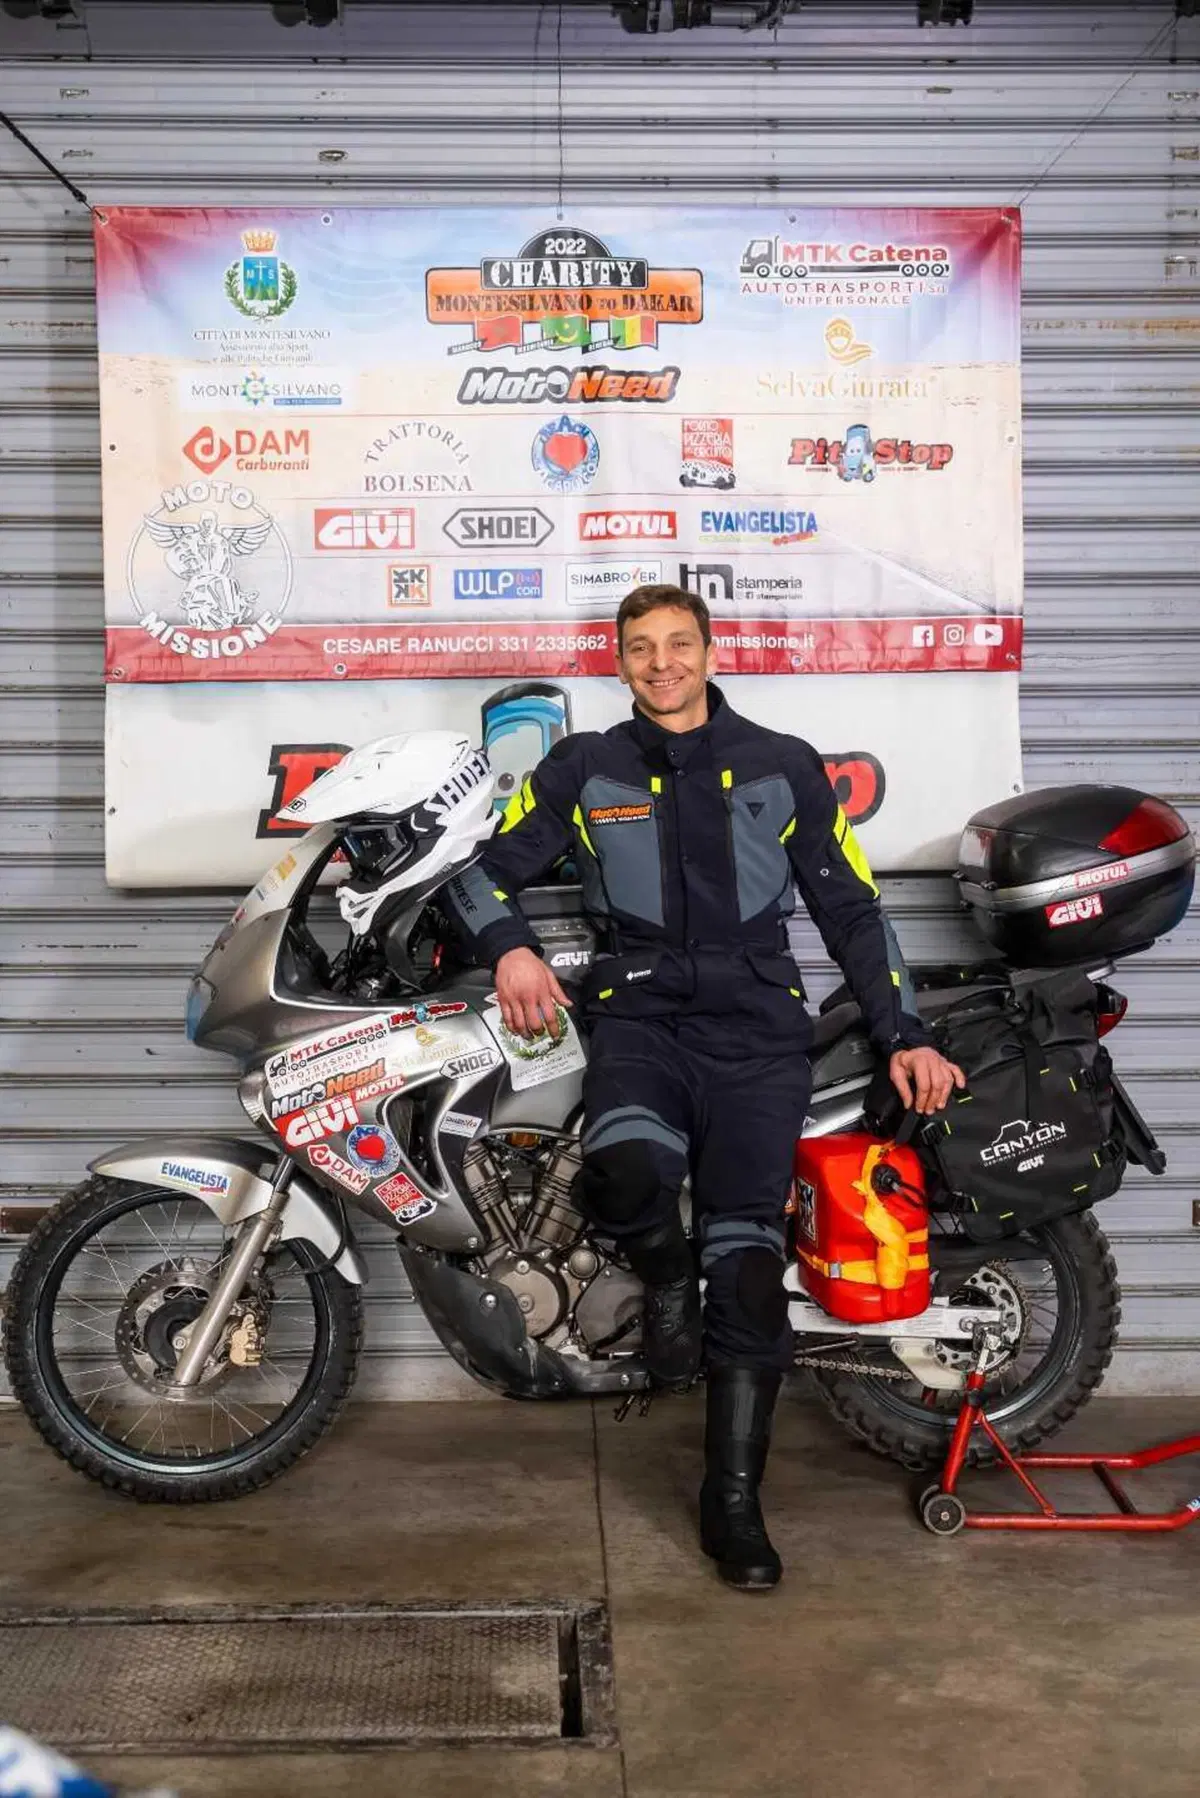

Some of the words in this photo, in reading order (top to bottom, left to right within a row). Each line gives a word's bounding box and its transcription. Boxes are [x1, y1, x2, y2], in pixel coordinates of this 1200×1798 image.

[545, 238, 587, 255] 2022
[781, 244, 844, 263] MTK
[849, 244, 948, 263] Catena
[490, 260, 637, 287] CHARITY
[742, 281, 924, 294] AUTOTRASPORTI
[784, 295, 911, 305] UNIPERSONALE
[435, 293, 593, 312] MONTESILVANO
[622, 293, 695, 312] DAKAR
[235, 429, 310, 456] DAM
[363, 422, 471, 465] TRATTORIA
[787, 437, 845, 466] Pit
[873, 437, 954, 471] Stop
[236, 458, 310, 471] Carburanti
[161, 480, 254, 512] MOTO
[364, 475, 475, 492] BOLSENA
[318, 515, 412, 549] GIVI
[460, 516, 538, 540] SHOEI
[582, 514, 674, 538] MOTUL
[701, 511, 818, 533] EVANGELISTA
[458, 571, 514, 596] WLP
[736, 576, 804, 593] stamperia
[140, 610, 283, 659] MISSIONE
[323, 638, 402, 654] CESARE
[407, 636, 494, 653] RANUCCI
[499, 636, 529, 651] 331
[534, 634, 608, 652] 2335662
[1078, 865, 1127, 887] MOTUL
[1049, 896, 1103, 926] GIVI
[550, 951, 589, 968] GIVI
[290, 1042, 325, 1061] MTK
[326, 1022, 385, 1047] Catena
[447, 1050, 495, 1077] SHOEI
[355, 1075, 405, 1101] MOTUL
[285, 1096, 360, 1148] GIVI
[161, 1162, 228, 1190] EVANGELISTA
[331, 1158, 369, 1190] DAM
